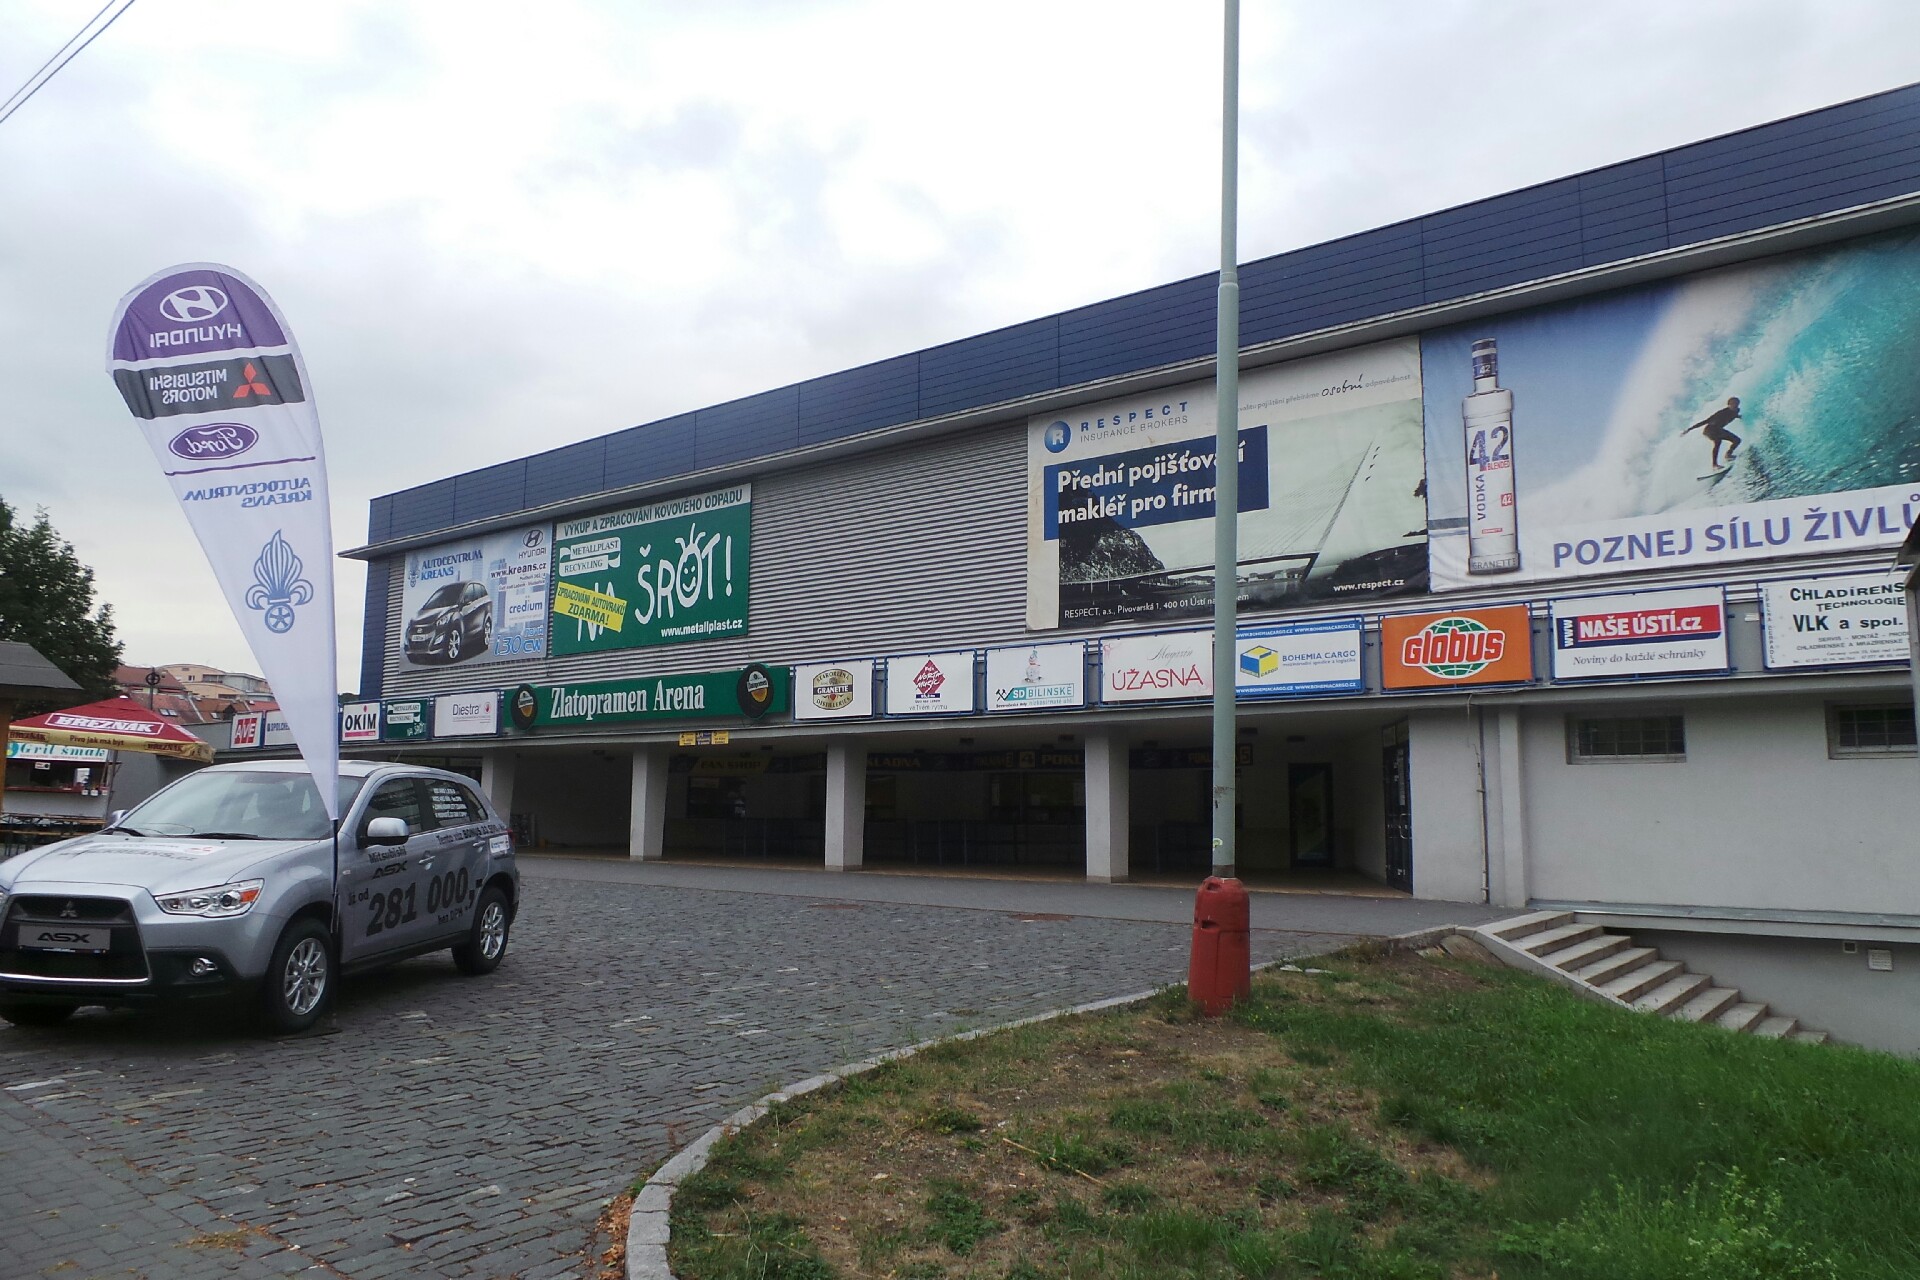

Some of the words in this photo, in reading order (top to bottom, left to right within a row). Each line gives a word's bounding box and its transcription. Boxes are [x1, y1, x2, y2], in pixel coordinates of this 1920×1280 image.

[1080, 401, 1189, 432] RESPECT
[1080, 425, 1137, 443] INSURANCE
[1140, 415, 1189, 431] BROKERS
[1468, 425, 1510, 472] 42
[1057, 463, 1124, 494] Přední
[1128, 439, 1244, 485] pojišťoví
[1477, 474, 1486, 521] VODKA
[564, 520, 590, 537] VÝKUP
[592, 519, 598, 531] A
[599, 507, 652, 530] ZPRACOVÁNÍ
[654, 498, 701, 518] KOVOVÉHO
[705, 489, 743, 508] ODPADU
[1057, 494, 1127, 524] makléř
[1131, 494, 1167, 520] pro
[572, 540, 619, 556] METALLPLAST
[1553, 529, 1693, 569] POZNEJ
[1705, 515, 1792, 552] SÍLU
[421, 549, 483, 570] AUTOCENTRUM
[518, 547, 547, 559] HYUNDAI
[421, 566, 454, 580] KREANS
[490, 562, 547, 579] www.kreans.cz
[564, 559, 603, 573] RECYKLING
[1333, 577, 1405, 592] www.respect.cz
[509, 600, 543, 614] credium
[1163, 601, 1178, 609] 400
[1179, 599, 1188, 607] 01
[1816, 597, 1905, 612] TECHNOLOGIE
[567, 602, 610, 626] ZDARMA!
[1793, 614, 1829, 633] VLK
[1839, 619, 1850, 630] a
[1860, 617, 1904, 630] spol.
[661, 618, 743, 638] www.metallplast.cz
[1564, 619, 1574, 648] WWW
[1579, 615, 1630, 640] NAŠE
[1633, 611, 1702, 635] ÚSTÍ.cz
[1282, 652, 1322, 662] BOHEMIA
[1324, 650, 1357, 659] CARGO
[1402, 629, 1504, 666] Globus
[1573, 653, 1608, 666] Noviny
[1609, 652, 1623, 662] do
[1625, 649, 1656, 662] každé
[1657, 648, 1707, 662] schránky
[1112, 664, 1204, 691] ÚŽASNÁ
[817, 685, 849, 694] GRANETTE
[1013, 690, 1025, 699] SD
[1028, 683, 1073, 698] BÍLINSKÉ
[452, 703, 479, 716] Diestra
[551, 687, 648, 721] Zlatopramen
[653, 679, 705, 711] Arena
[236, 724, 256, 739] AVE
[345, 713, 377, 731] OKIM
[368, 845, 407, 864] Mitsubishi
[371, 860, 408, 880] ASX
[366, 882, 417, 937] 281
[37, 932, 91, 944] ASX
